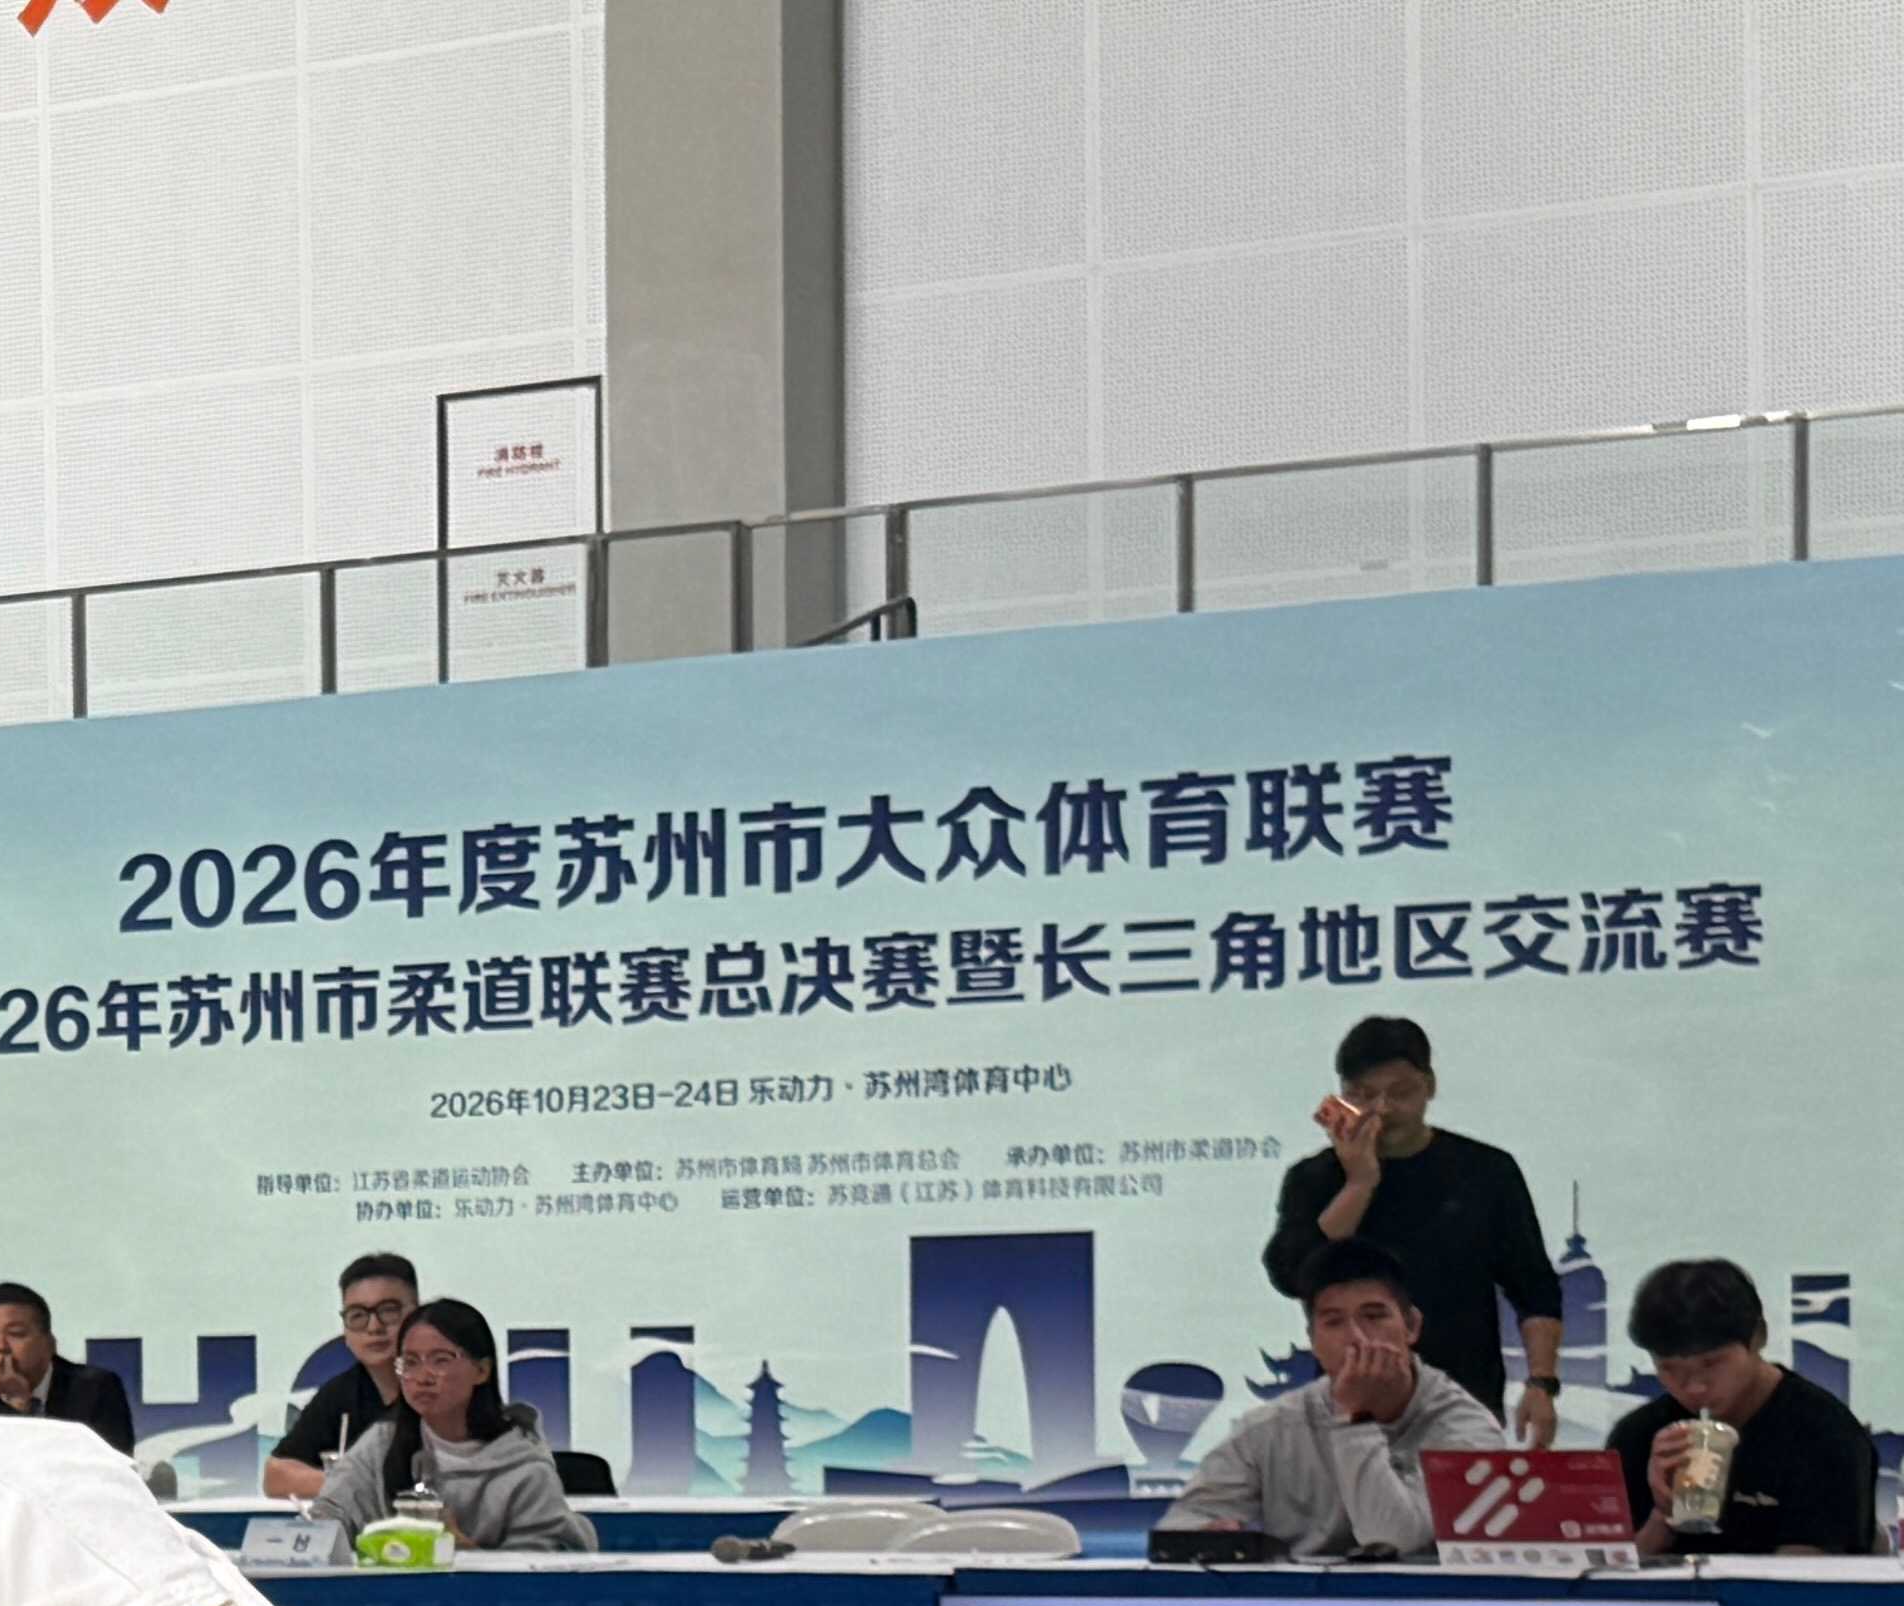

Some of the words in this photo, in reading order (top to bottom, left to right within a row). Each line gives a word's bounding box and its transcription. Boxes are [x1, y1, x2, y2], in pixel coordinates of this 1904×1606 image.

[119, 755, 1453, 932] 2026年度苏州市大众体育联赛
